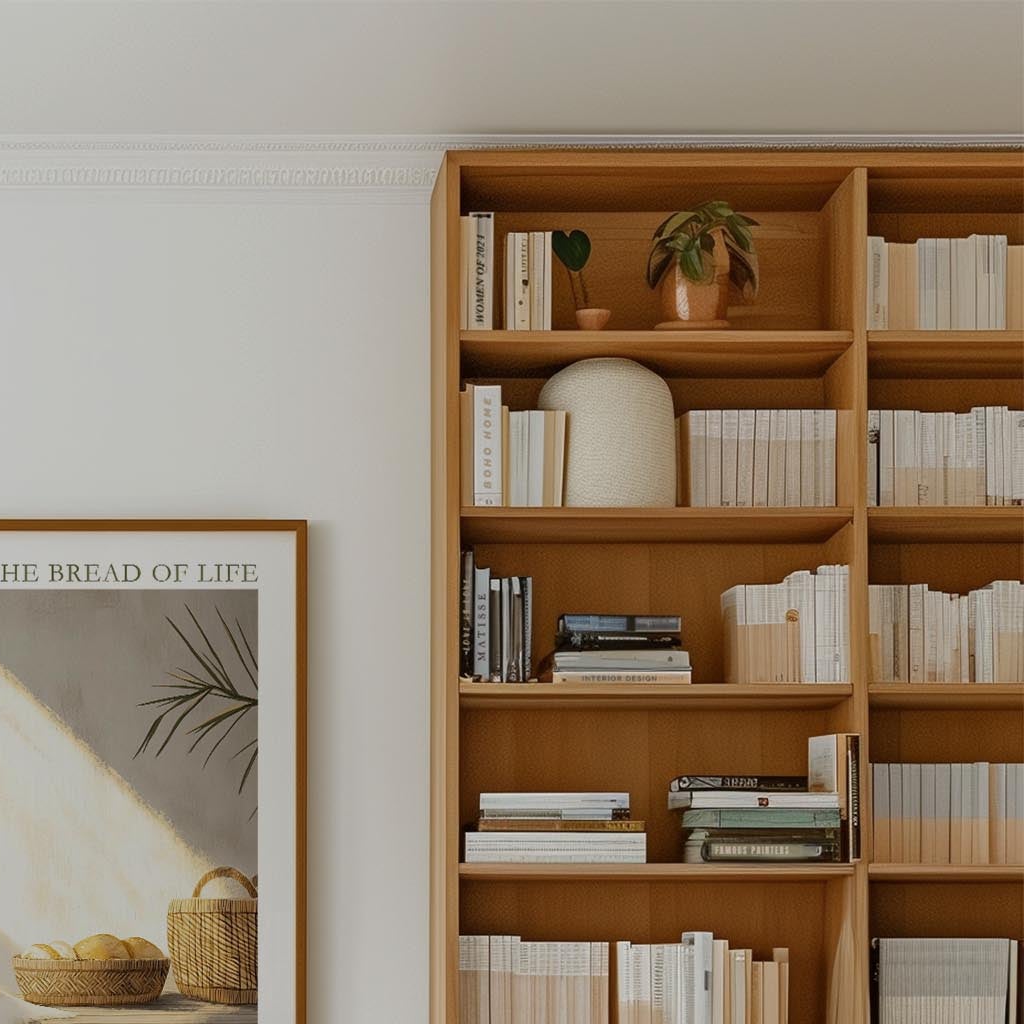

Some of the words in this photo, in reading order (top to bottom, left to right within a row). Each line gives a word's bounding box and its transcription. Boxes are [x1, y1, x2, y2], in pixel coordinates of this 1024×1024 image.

[476, 234, 485, 258] 2024
[476, 260, 485, 276] OF
[474, 279, 485, 324] WOMEN
[483, 398, 492, 440] HOME
[483, 447, 492, 489] BOHO
[48, 563, 141, 583] BREAD
[152, 563, 189, 583] OF
[197, 563, 258, 583] LIFE
[477, 593, 487, 661] MATISSE
[714, 845, 748, 855] FAMOUS
[751, 845, 789, 855] PAINTERS
